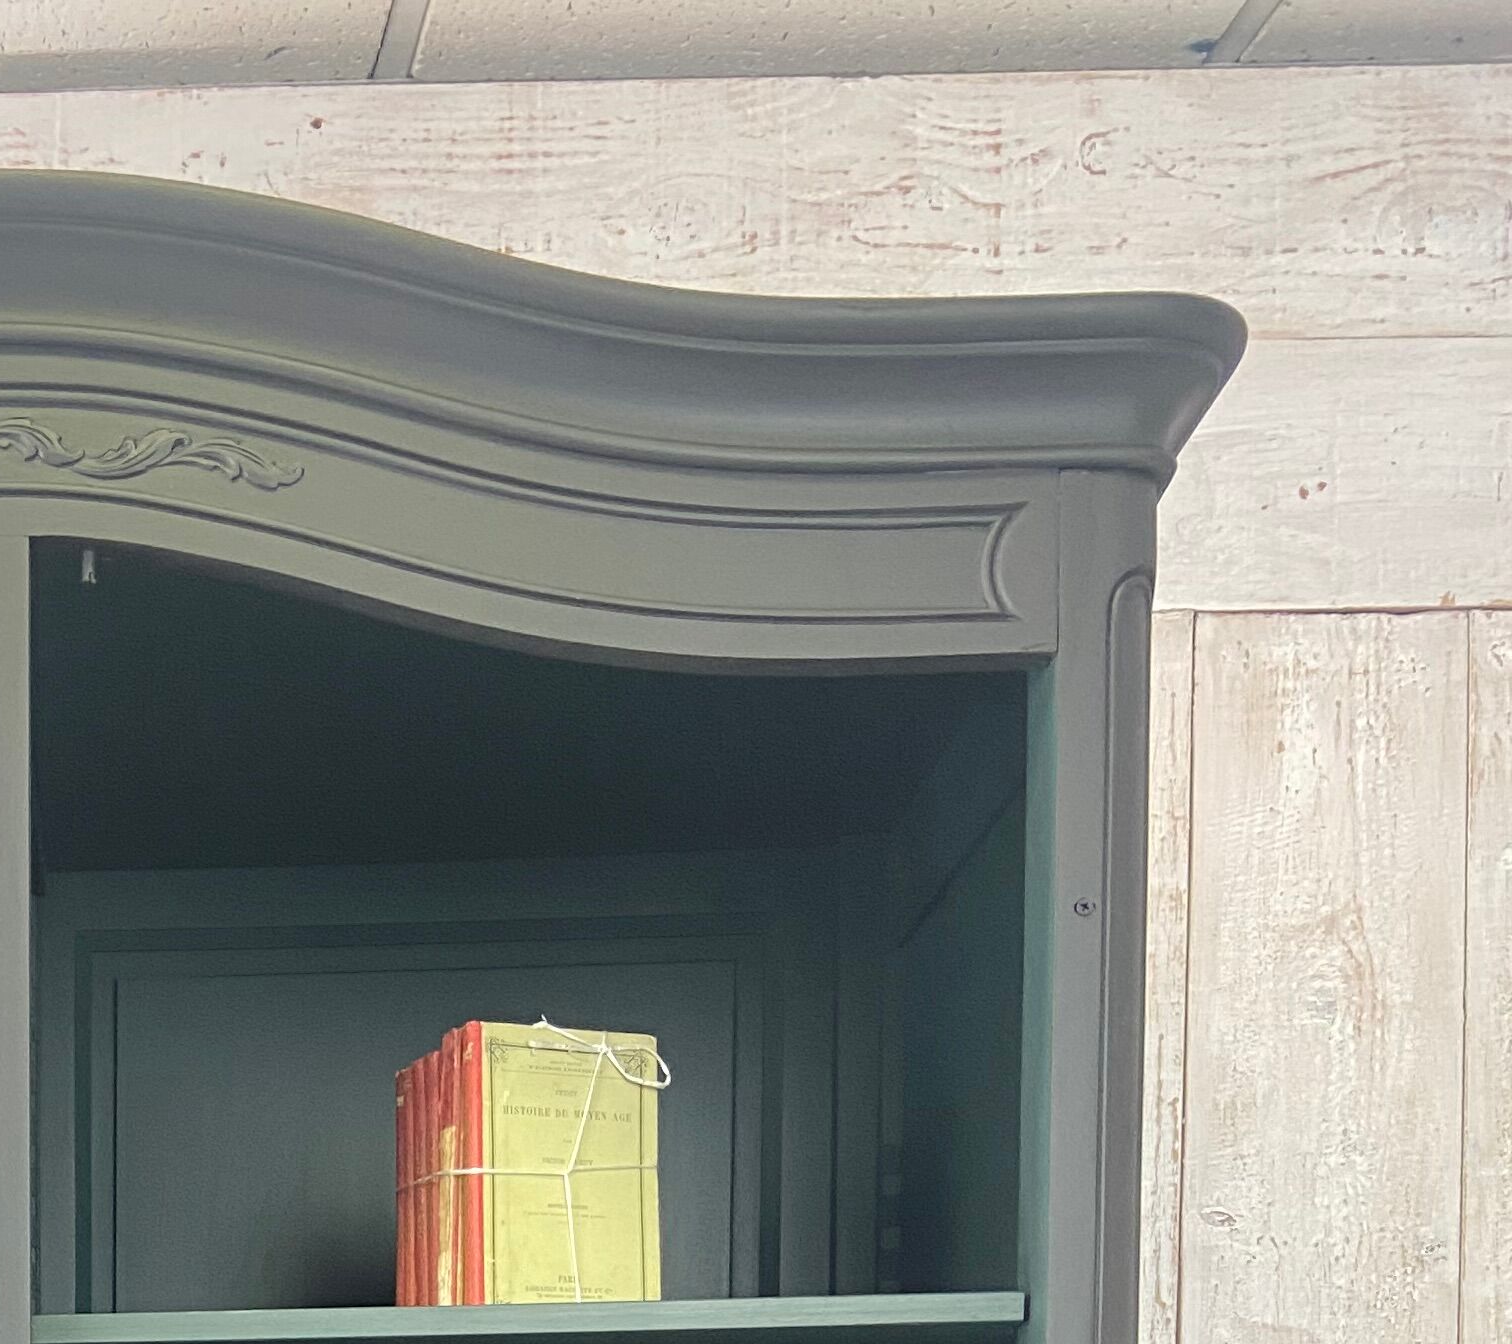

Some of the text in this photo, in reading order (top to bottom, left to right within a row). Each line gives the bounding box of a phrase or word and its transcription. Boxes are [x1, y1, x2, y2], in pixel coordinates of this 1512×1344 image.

[502, 1104, 551, 1118] HISTOIRE
[555, 1108, 569, 1119] DU
[613, 1112, 633, 1123] AGE
[558, 1274, 578, 1284] PARI
